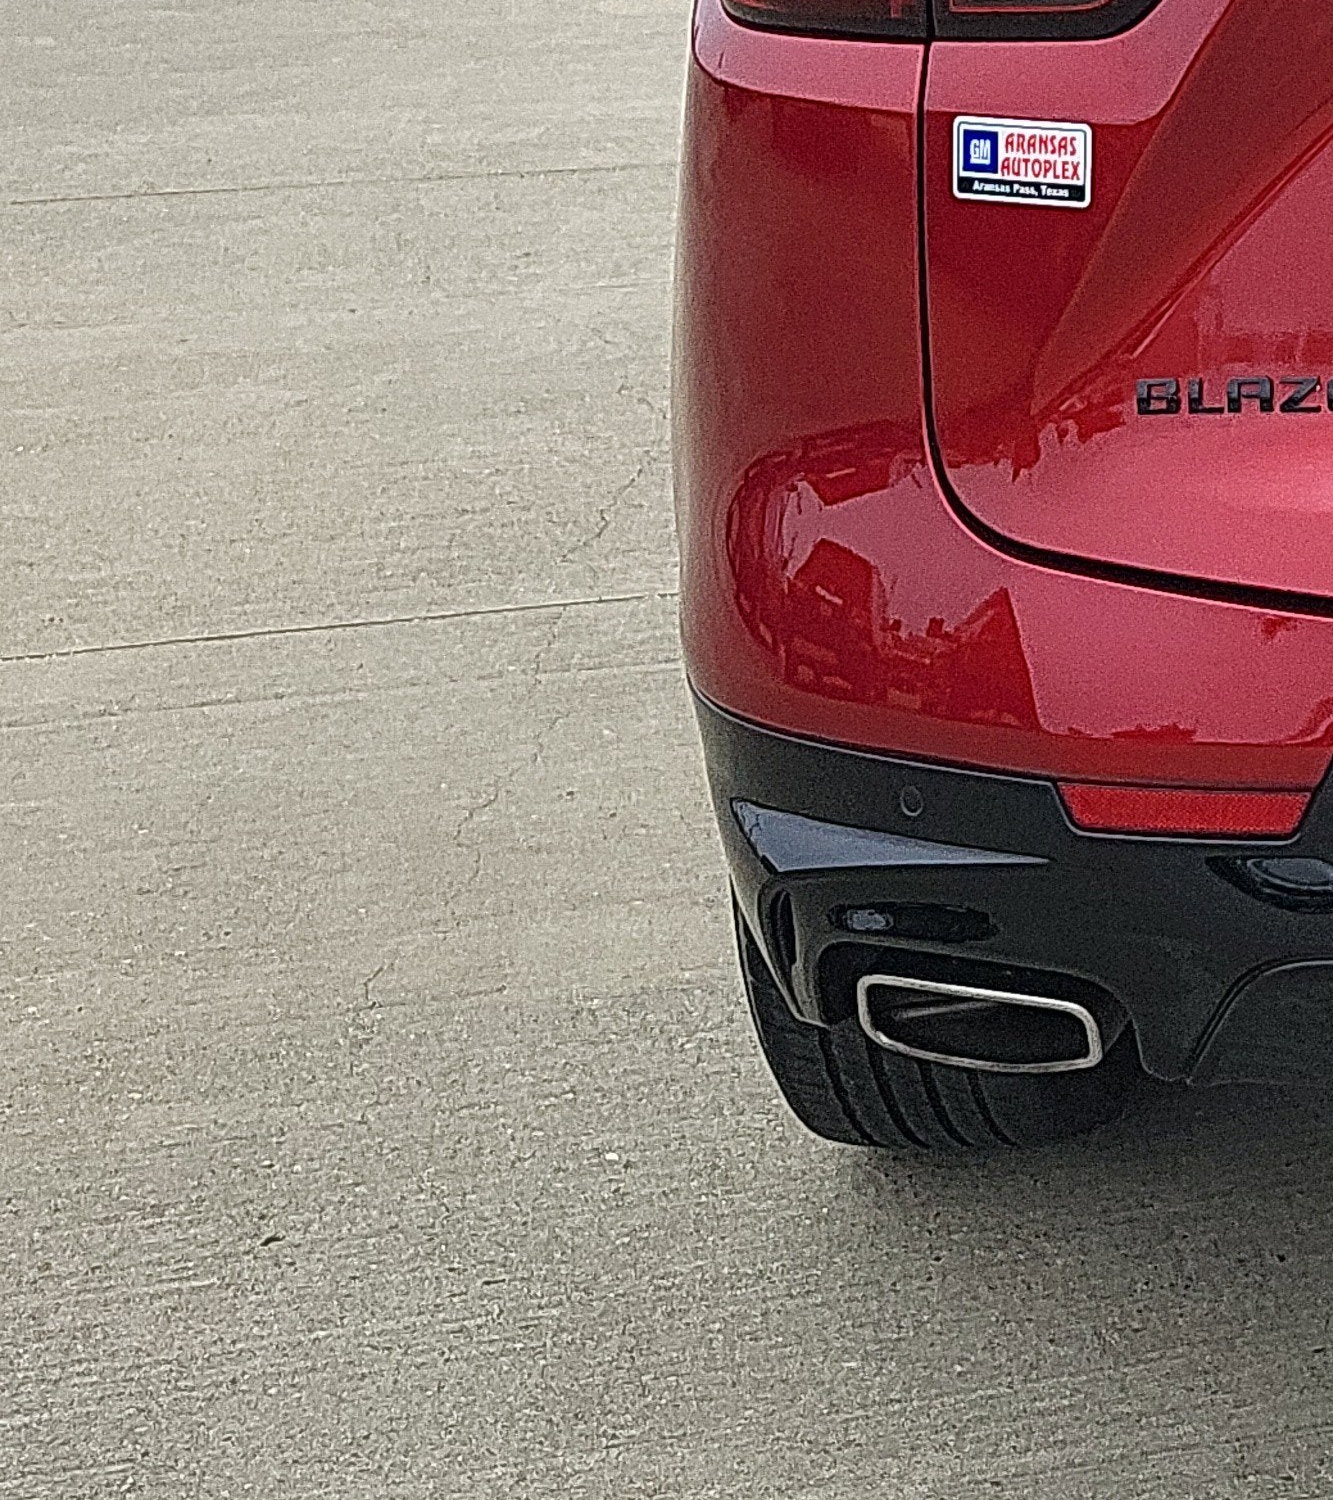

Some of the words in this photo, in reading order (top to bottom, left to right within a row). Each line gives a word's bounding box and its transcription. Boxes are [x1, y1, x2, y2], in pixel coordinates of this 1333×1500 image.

[970, 139, 991, 165] GM
[1005, 132, 1077, 158] ARANSAS
[1000, 157, 1081, 181] AUTOPLEX
[972, 180, 1011, 194] Aransas
[1013, 184, 1038, 197] Pass,
[1041, 185, 1069, 198] Texas
